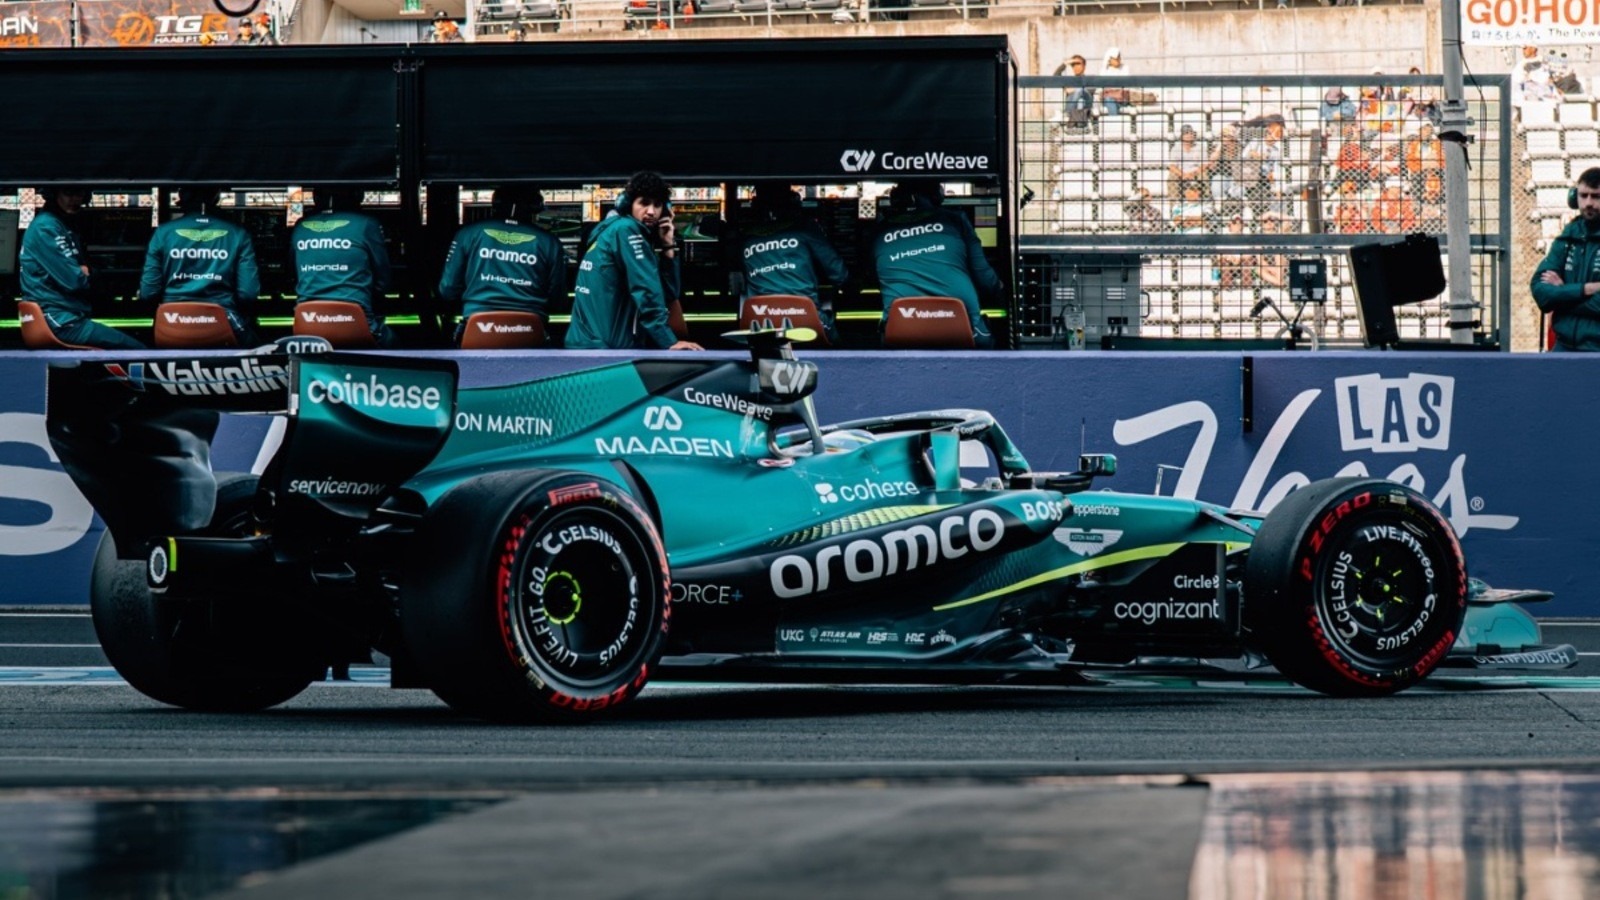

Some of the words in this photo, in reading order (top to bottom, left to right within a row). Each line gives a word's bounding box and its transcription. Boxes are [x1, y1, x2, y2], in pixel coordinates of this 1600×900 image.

[0, 16, 38, 36] AN
[154, 15, 228, 33] TGR
[881, 152, 988, 170] CoreWeave
[297, 238, 352, 250] aramco
[884, 223, 943, 243] aramco
[170, 248, 228, 259] aramco
[479, 247, 538, 265] aramco
[743, 238, 799, 258] aramco
[901, 244, 945, 258] Honda
[149, 358, 290, 396] Valvolin
[307, 373, 440, 411] coinbase
[684, 387, 774, 421] CoreWeave
[1346, 382, 1443, 444] LAS
[487, 413, 553, 437] MARTIN
[595, 437, 734, 459] MAADEN
[288, 476, 386, 495] servicenow
[840, 480, 920, 502] cohere
[1020, 501, 1064, 523] BOSS
[1309, 491, 1372, 553] ZERO
[558, 524, 622, 555] CELSIUS
[769, 508, 1006, 599] aramco
[1331, 550, 1353, 623] CELSIUS
[1114, 598, 1220, 625] cognizant
[780, 629, 804, 642] UKG
[1376, 612, 1430, 651] CELSIUS
